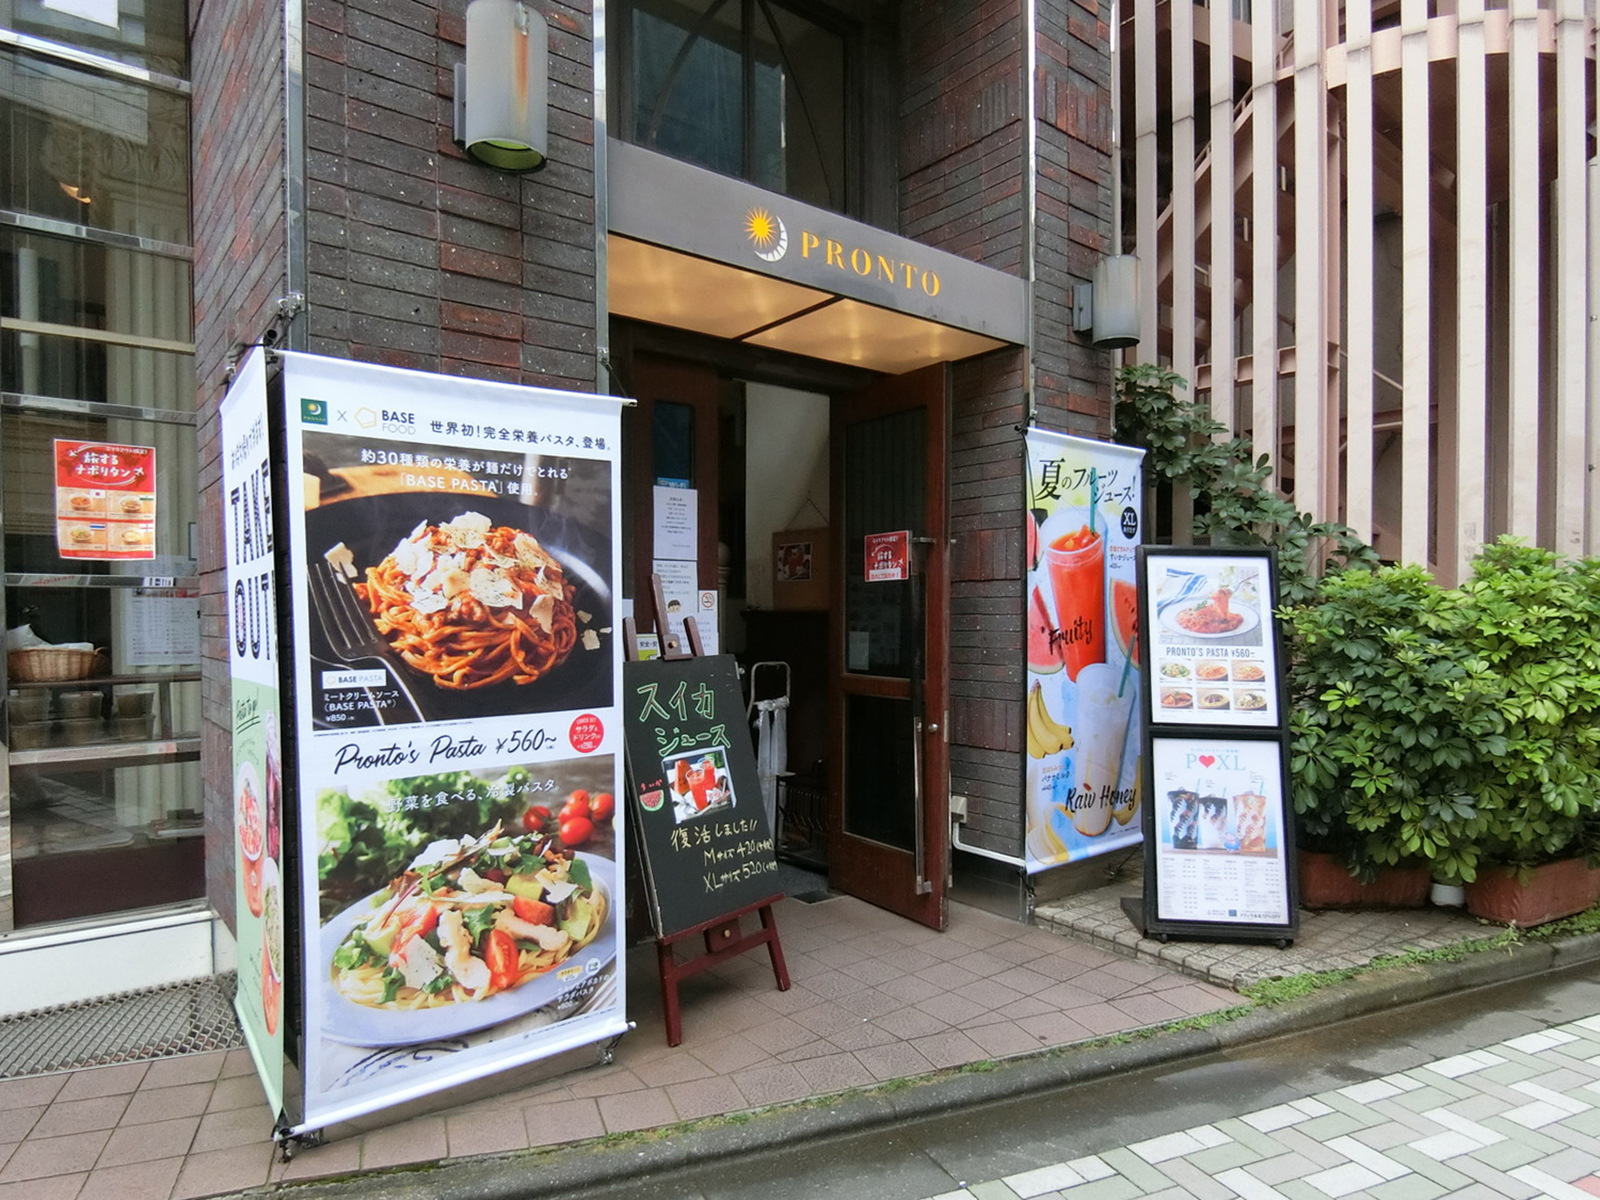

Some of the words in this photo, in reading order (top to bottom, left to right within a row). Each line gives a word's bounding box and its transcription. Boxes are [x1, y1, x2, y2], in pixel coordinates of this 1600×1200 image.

[802, 231, 941, 297] PRONTO
[382, 410, 415, 425] BASE
[382, 421, 416, 435] FOOD
[83, 452, 119, 464] 旅する
[75, 464, 131, 477] ナポリタン
[1034, 457, 1119, 501] 夏のフルーツ
[230, 458, 273, 566] TAKE
[1123, 511, 1137, 526] XL
[1048, 615, 1093, 655] Fruity
[1166, 646, 1204, 658] PRONTO'S
[1206, 647, 1229, 658] PASTA
[338, 676, 357, 684] BASE
[359, 675, 383, 683] PASTA
[324, 690, 399, 701] ミートクリームソース
[637, 681, 715, 722] スイカ
[325, 713, 347, 722] ¥850
[654, 723, 731, 757] ジュース
[334, 743, 420, 775] Pronto's
[429, 734, 488, 764] Pasta
[1065, 786, 1096, 813] Raw
[1100, 784, 1137, 811] Honey
